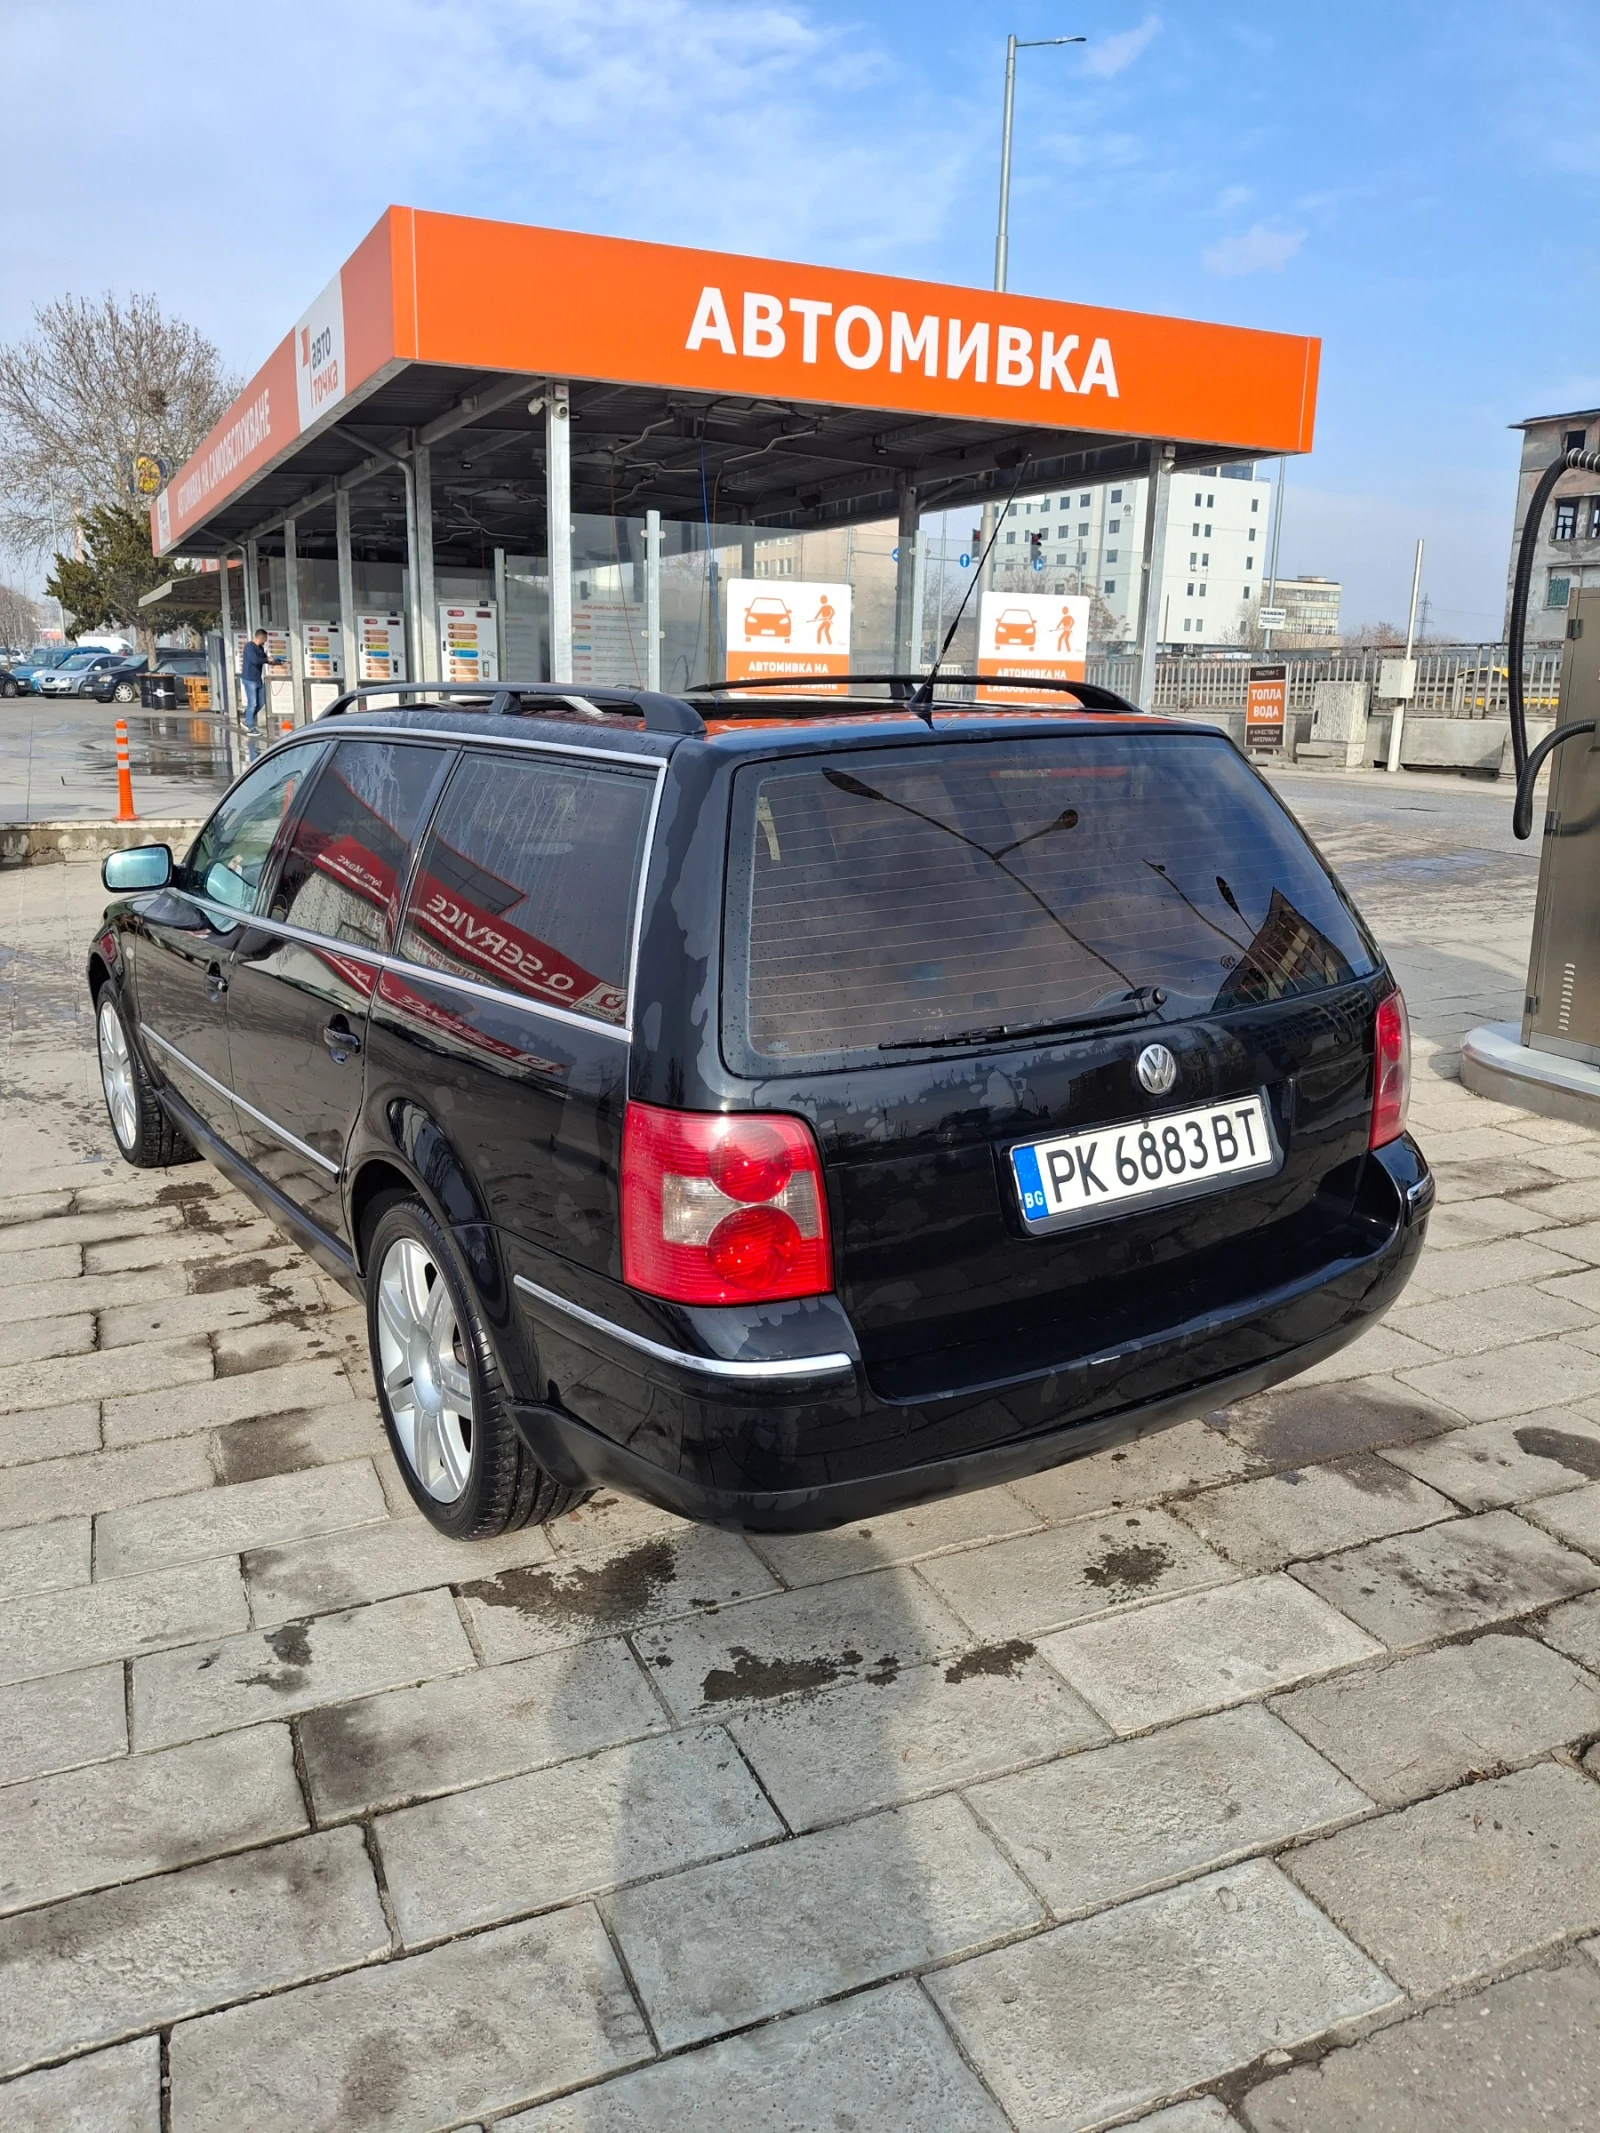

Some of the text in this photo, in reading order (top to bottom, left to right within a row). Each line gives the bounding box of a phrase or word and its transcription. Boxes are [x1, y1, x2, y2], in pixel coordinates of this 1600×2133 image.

[312, 326, 331, 371] авто
[685, 286, 1120, 398] АВТОМИВКА
[313, 359, 338, 406] точка
[748, 661, 828, 674] АВТОМИВКА НА
[997, 668, 1067, 679] АВТОМИВКА НА
[1251, 688, 1282, 700] ТОПЛА
[1253, 705, 1279, 719] ВОДА
[1046, 1108, 1256, 1203] PK 6883 BT
[1024, 1190, 1044, 1209] BG
